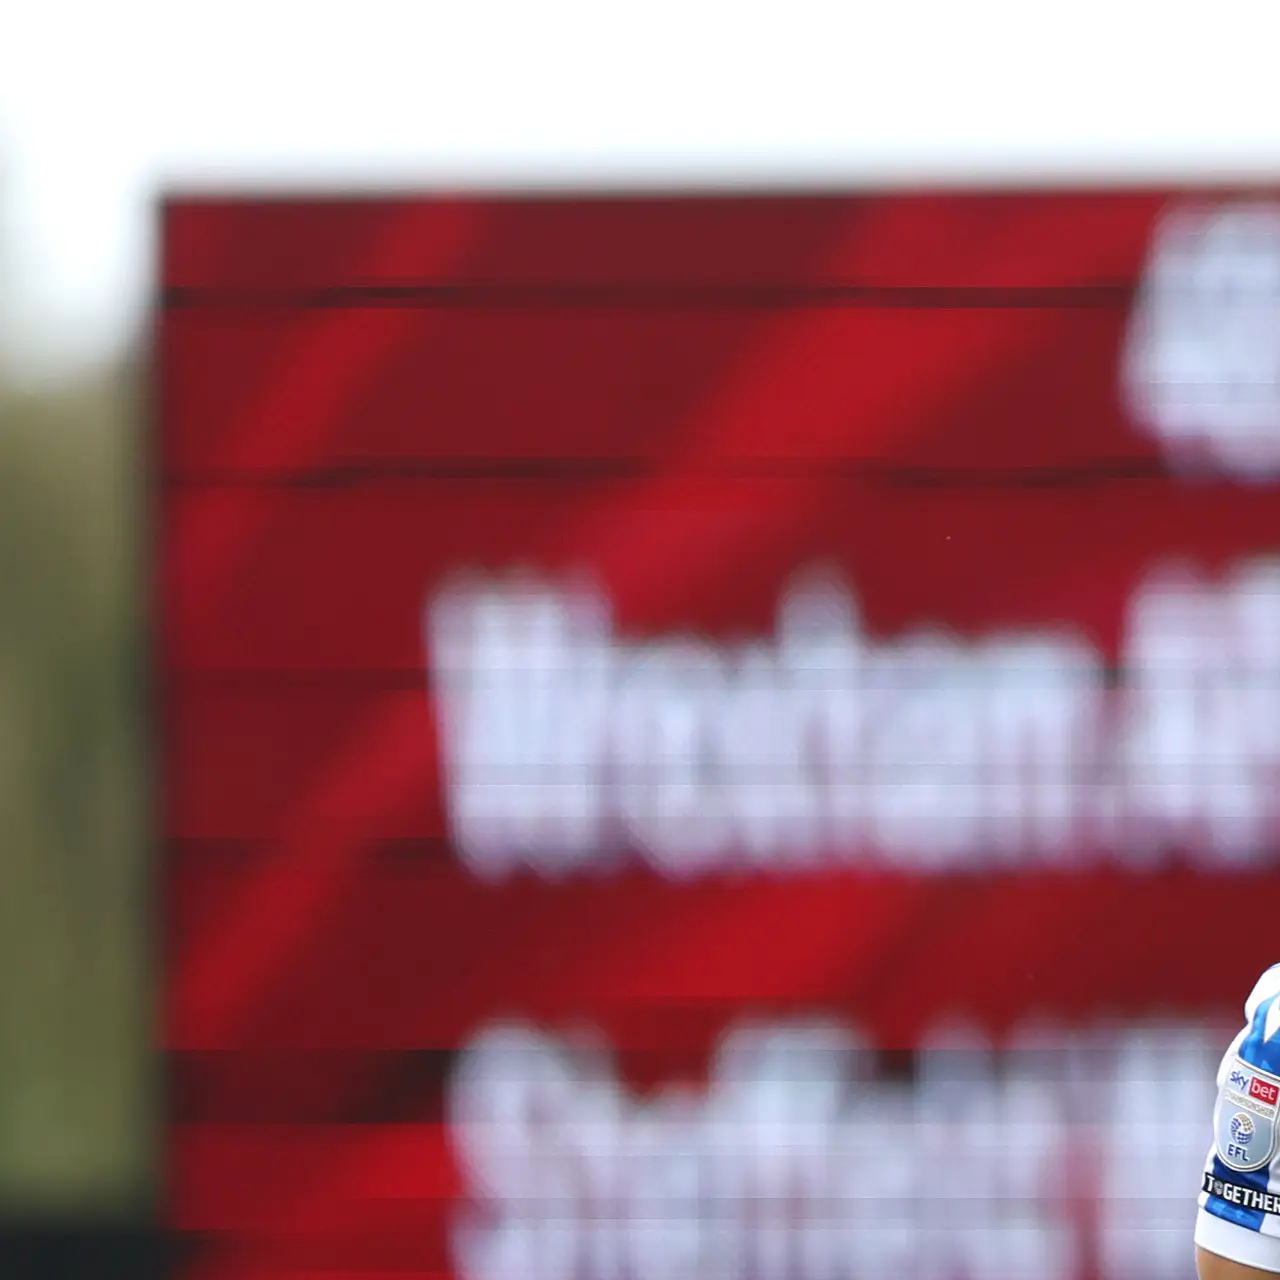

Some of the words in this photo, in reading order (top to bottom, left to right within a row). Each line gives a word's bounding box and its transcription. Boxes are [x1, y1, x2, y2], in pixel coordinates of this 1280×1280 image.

[1230, 1070, 1249, 1091] sky
[1251, 1080, 1277, 1101] bet
[1227, 1143, 1249, 1162] EFL
